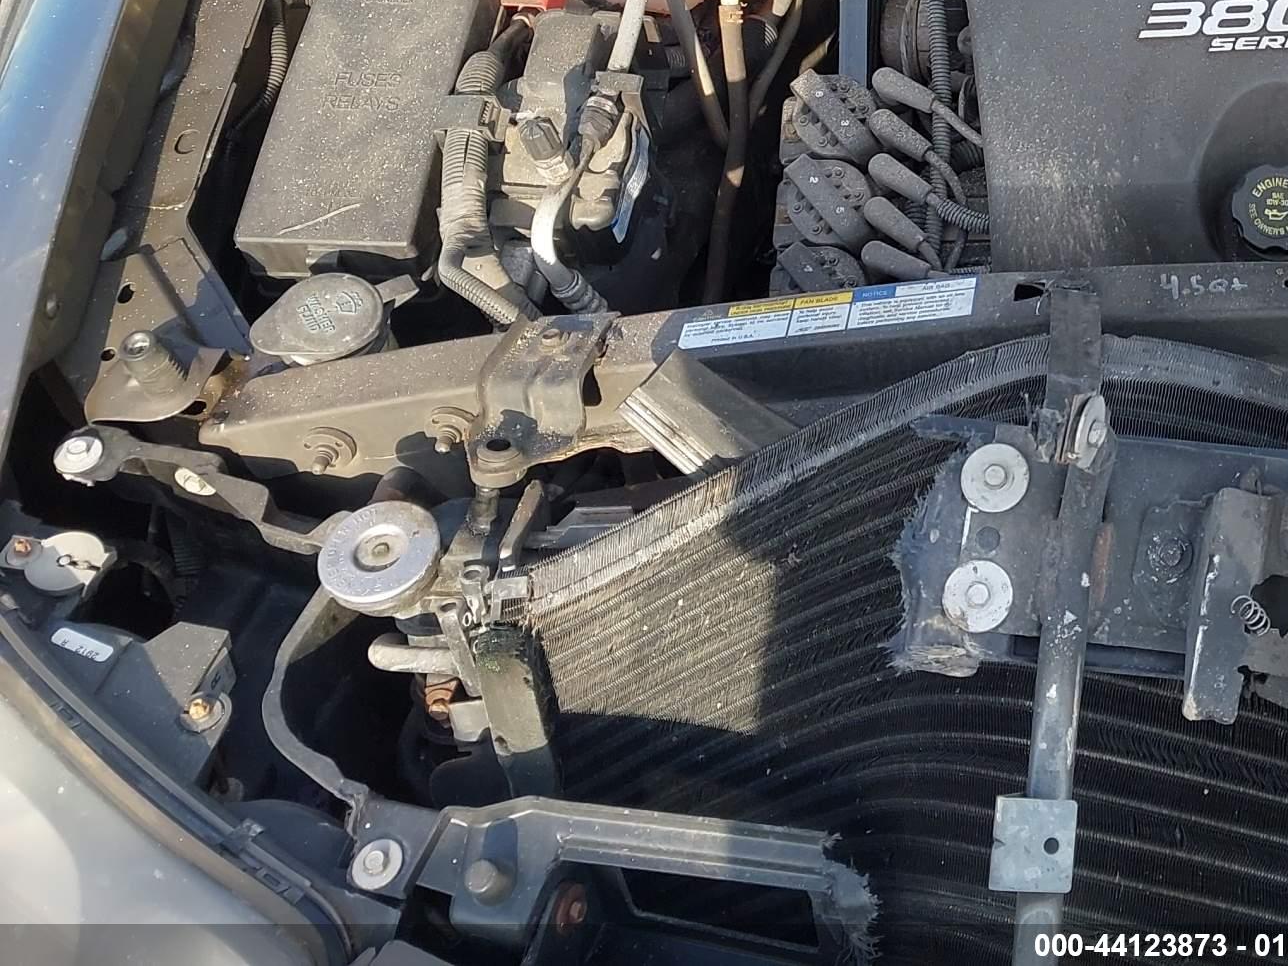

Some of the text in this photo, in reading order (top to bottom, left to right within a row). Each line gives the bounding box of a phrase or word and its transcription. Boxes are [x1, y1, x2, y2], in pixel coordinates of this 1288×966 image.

[334, 72, 402, 89] FUSES
[321, 94, 401, 112] RELAYS
[1248, 203, 1258, 219] SEE
[816, 296, 839, 304] BLADE
